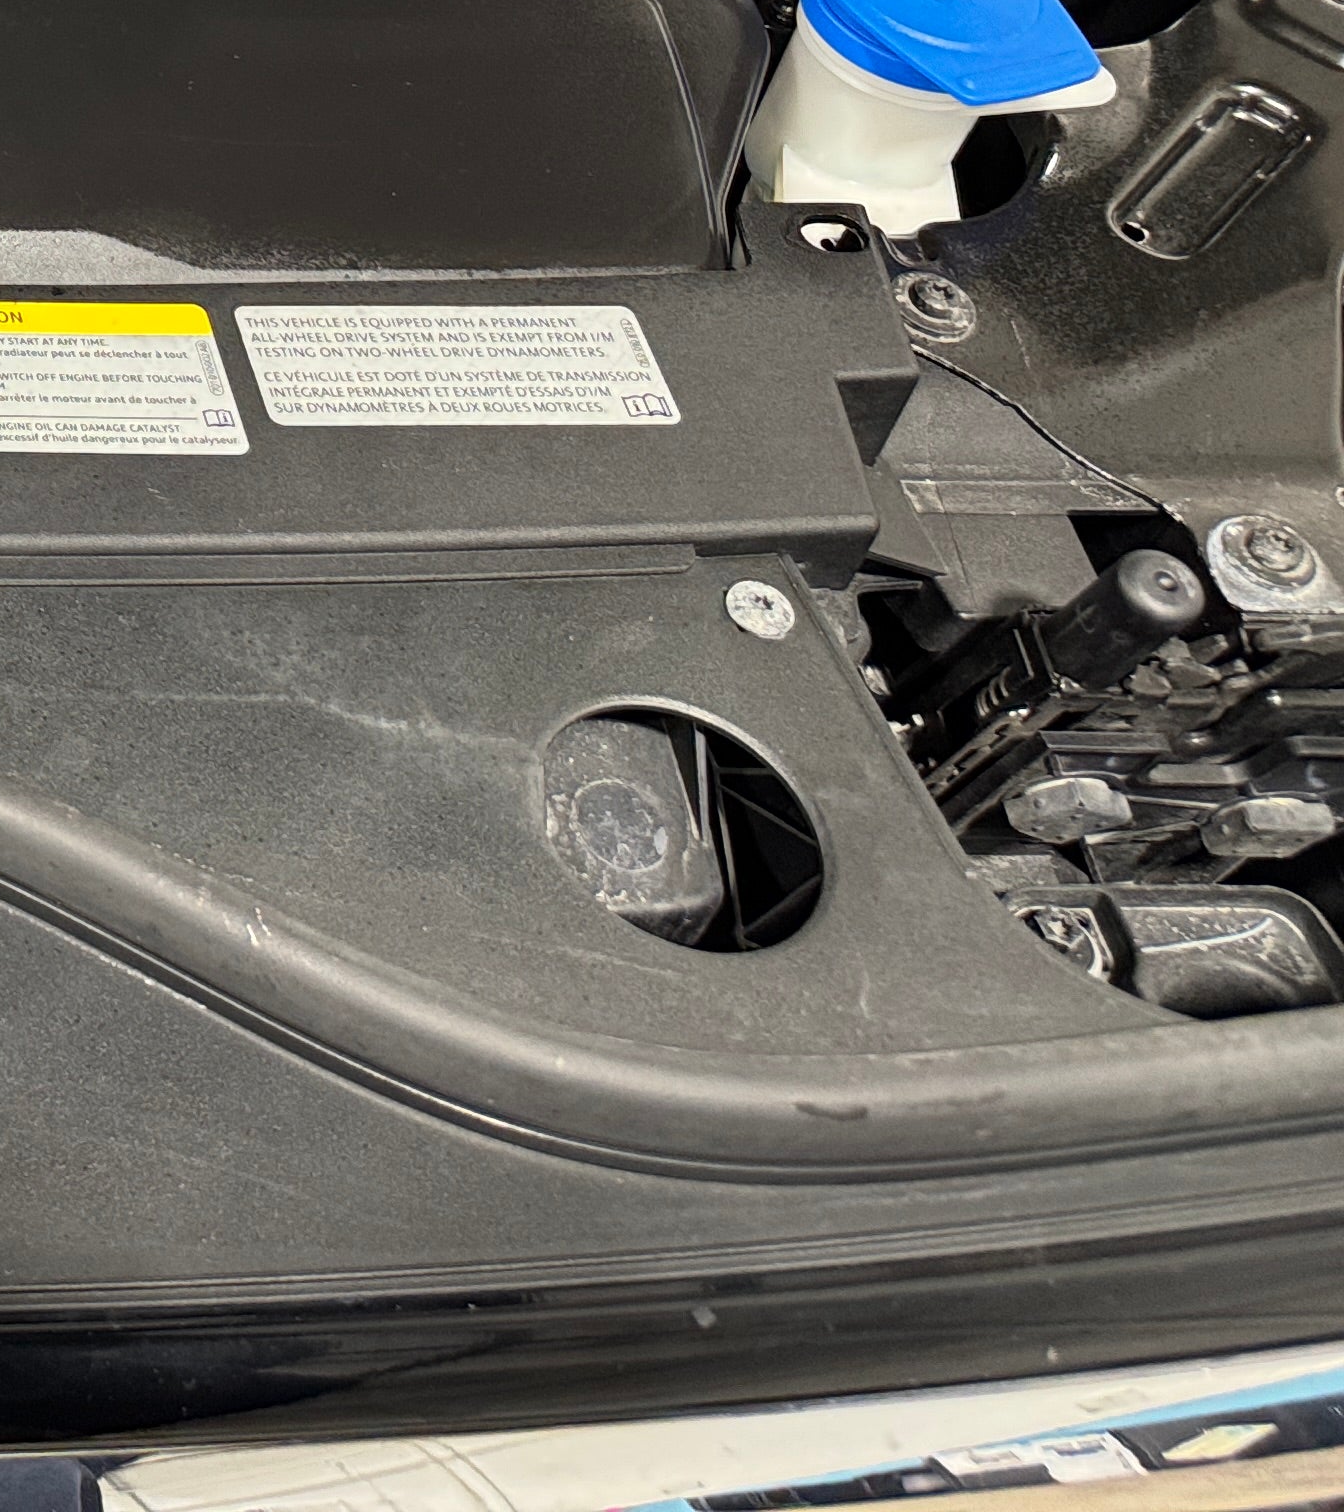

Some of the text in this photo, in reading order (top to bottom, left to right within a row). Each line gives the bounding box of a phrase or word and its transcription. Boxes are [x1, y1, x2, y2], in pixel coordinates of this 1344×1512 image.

[244, 317, 576, 328] THIS VEHICLE IS EQUIPPED WITH A PERMANENT
[7, 337, 39, 345] START
[42, 337, 53, 345] AT
[57, 337, 77, 346] ANY
[251, 332, 331, 343] ALL-WHEEL
[333, 332, 377, 343] DRIVE
[380, 332, 434, 342] SYSTEM
[438, 332, 470, 342] AND
[472, 332, 487, 342] IS
[488, 332, 542, 343] EXEMPT
[546, 332, 588, 342] FROM
[255, 346, 316, 357] TESTING
[319, 346, 343, 357] ON
[345, 346, 438, 357] TWO-WHEEL
[439, 346, 484, 357] DRIVE
[35, 372, 56, 381] OFF
[58, 373, 99, 382] ENGINE
[101, 374, 144, 382] BEFORE
[146, 374, 202, 383] TOUCHING
[263, 370, 651, 382] CE VÉHICULE EST DOTÉ D'UN SYSTÈME DE TRANSMISSION
[268, 385, 344, 398] INTÉGRALE
[346, 386, 430, 397] PERMANENT
[433, 386, 449, 397] ET
[452, 385, 513, 397] EXEMPTÉ
[515, 386, 573, 397] D'ESSAIS
[273, 402, 304, 413] SUR
[428, 400, 439, 412] À
[439, 401, 481, 413] DEUX
[482, 401, 531, 412] ROUES
[34, 422, 53, 431] OIL
[54, 422, 78, 431] CAN
[80, 423, 126, 432] DAMAGE
